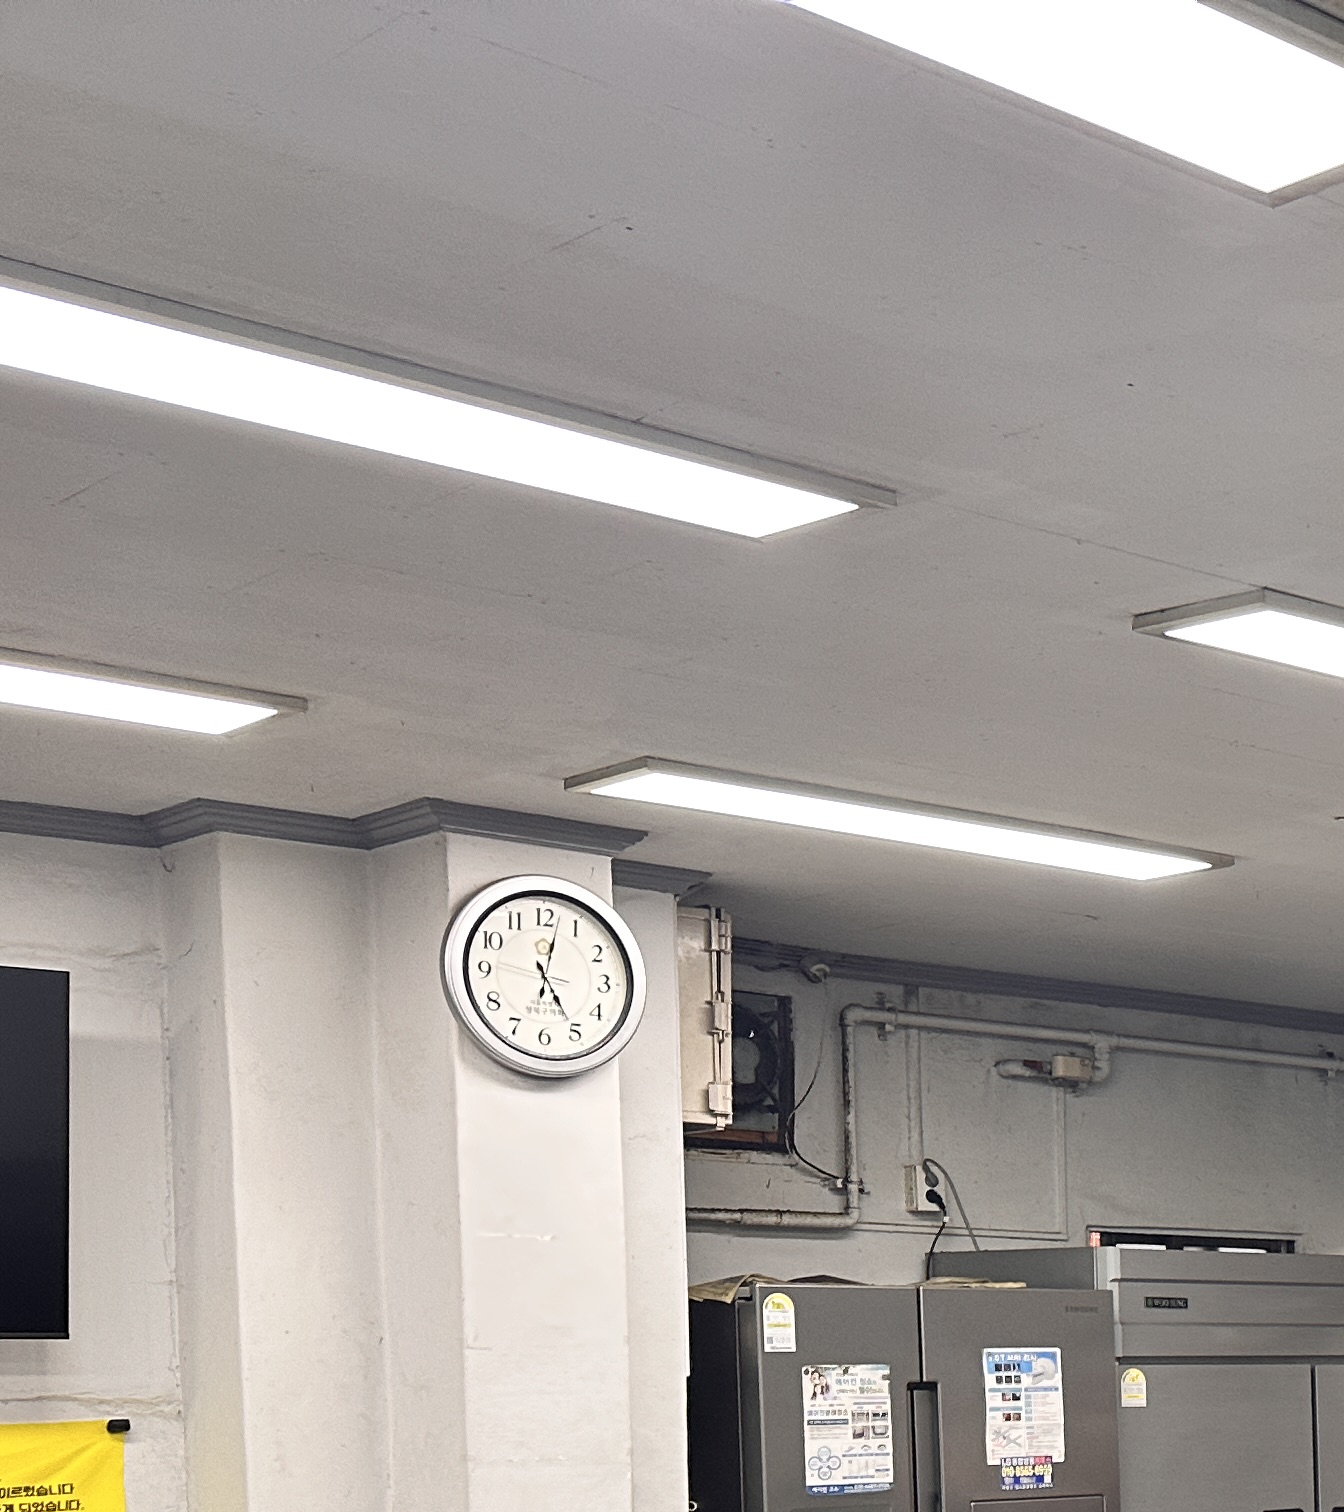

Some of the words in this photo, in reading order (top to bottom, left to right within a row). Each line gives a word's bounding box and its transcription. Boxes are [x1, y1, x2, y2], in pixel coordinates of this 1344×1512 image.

[507, 911, 523, 931] 11
[536, 908, 555, 928] 12
[572, 919, 579, 937] 1
[483, 930, 503, 950] 10
[592, 945, 603, 963] 2
[478, 961, 492, 979] 9
[597, 974, 611, 993] 3
[486, 991, 501, 1011] 8
[589, 1003, 603, 1021] 4
[508, 1017, 521, 1036] 7
[569, 1023, 582, 1041] 5
[538, 1027, 552, 1045] 6
